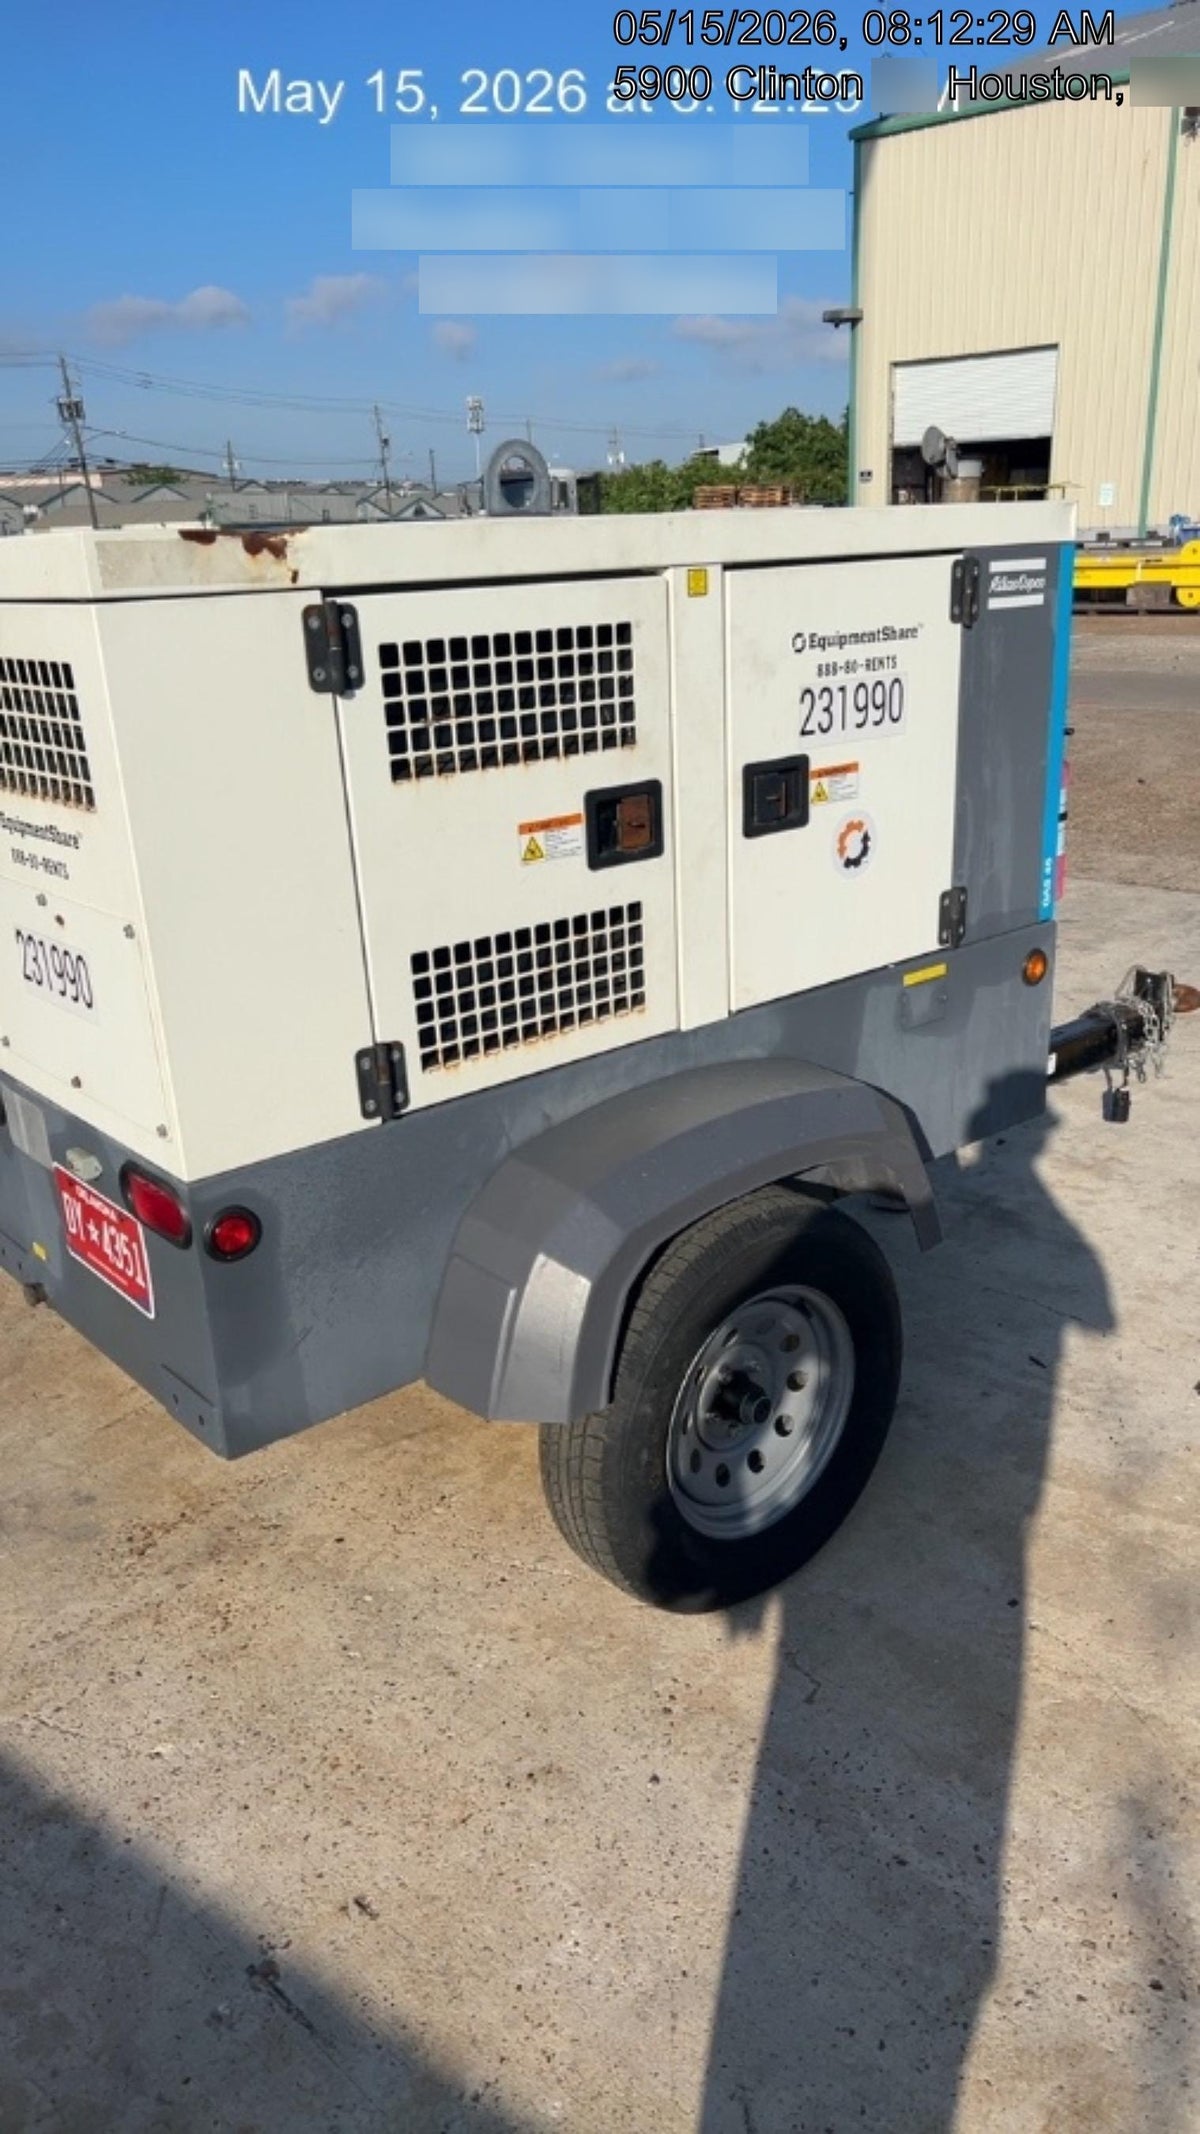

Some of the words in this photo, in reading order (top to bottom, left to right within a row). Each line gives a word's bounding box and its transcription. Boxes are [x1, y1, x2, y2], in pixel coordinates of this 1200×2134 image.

[808, 626, 919, 651] EquipmentShare
[799, 677, 904, 737] 231990
[15, 928, 94, 1009] 231990
